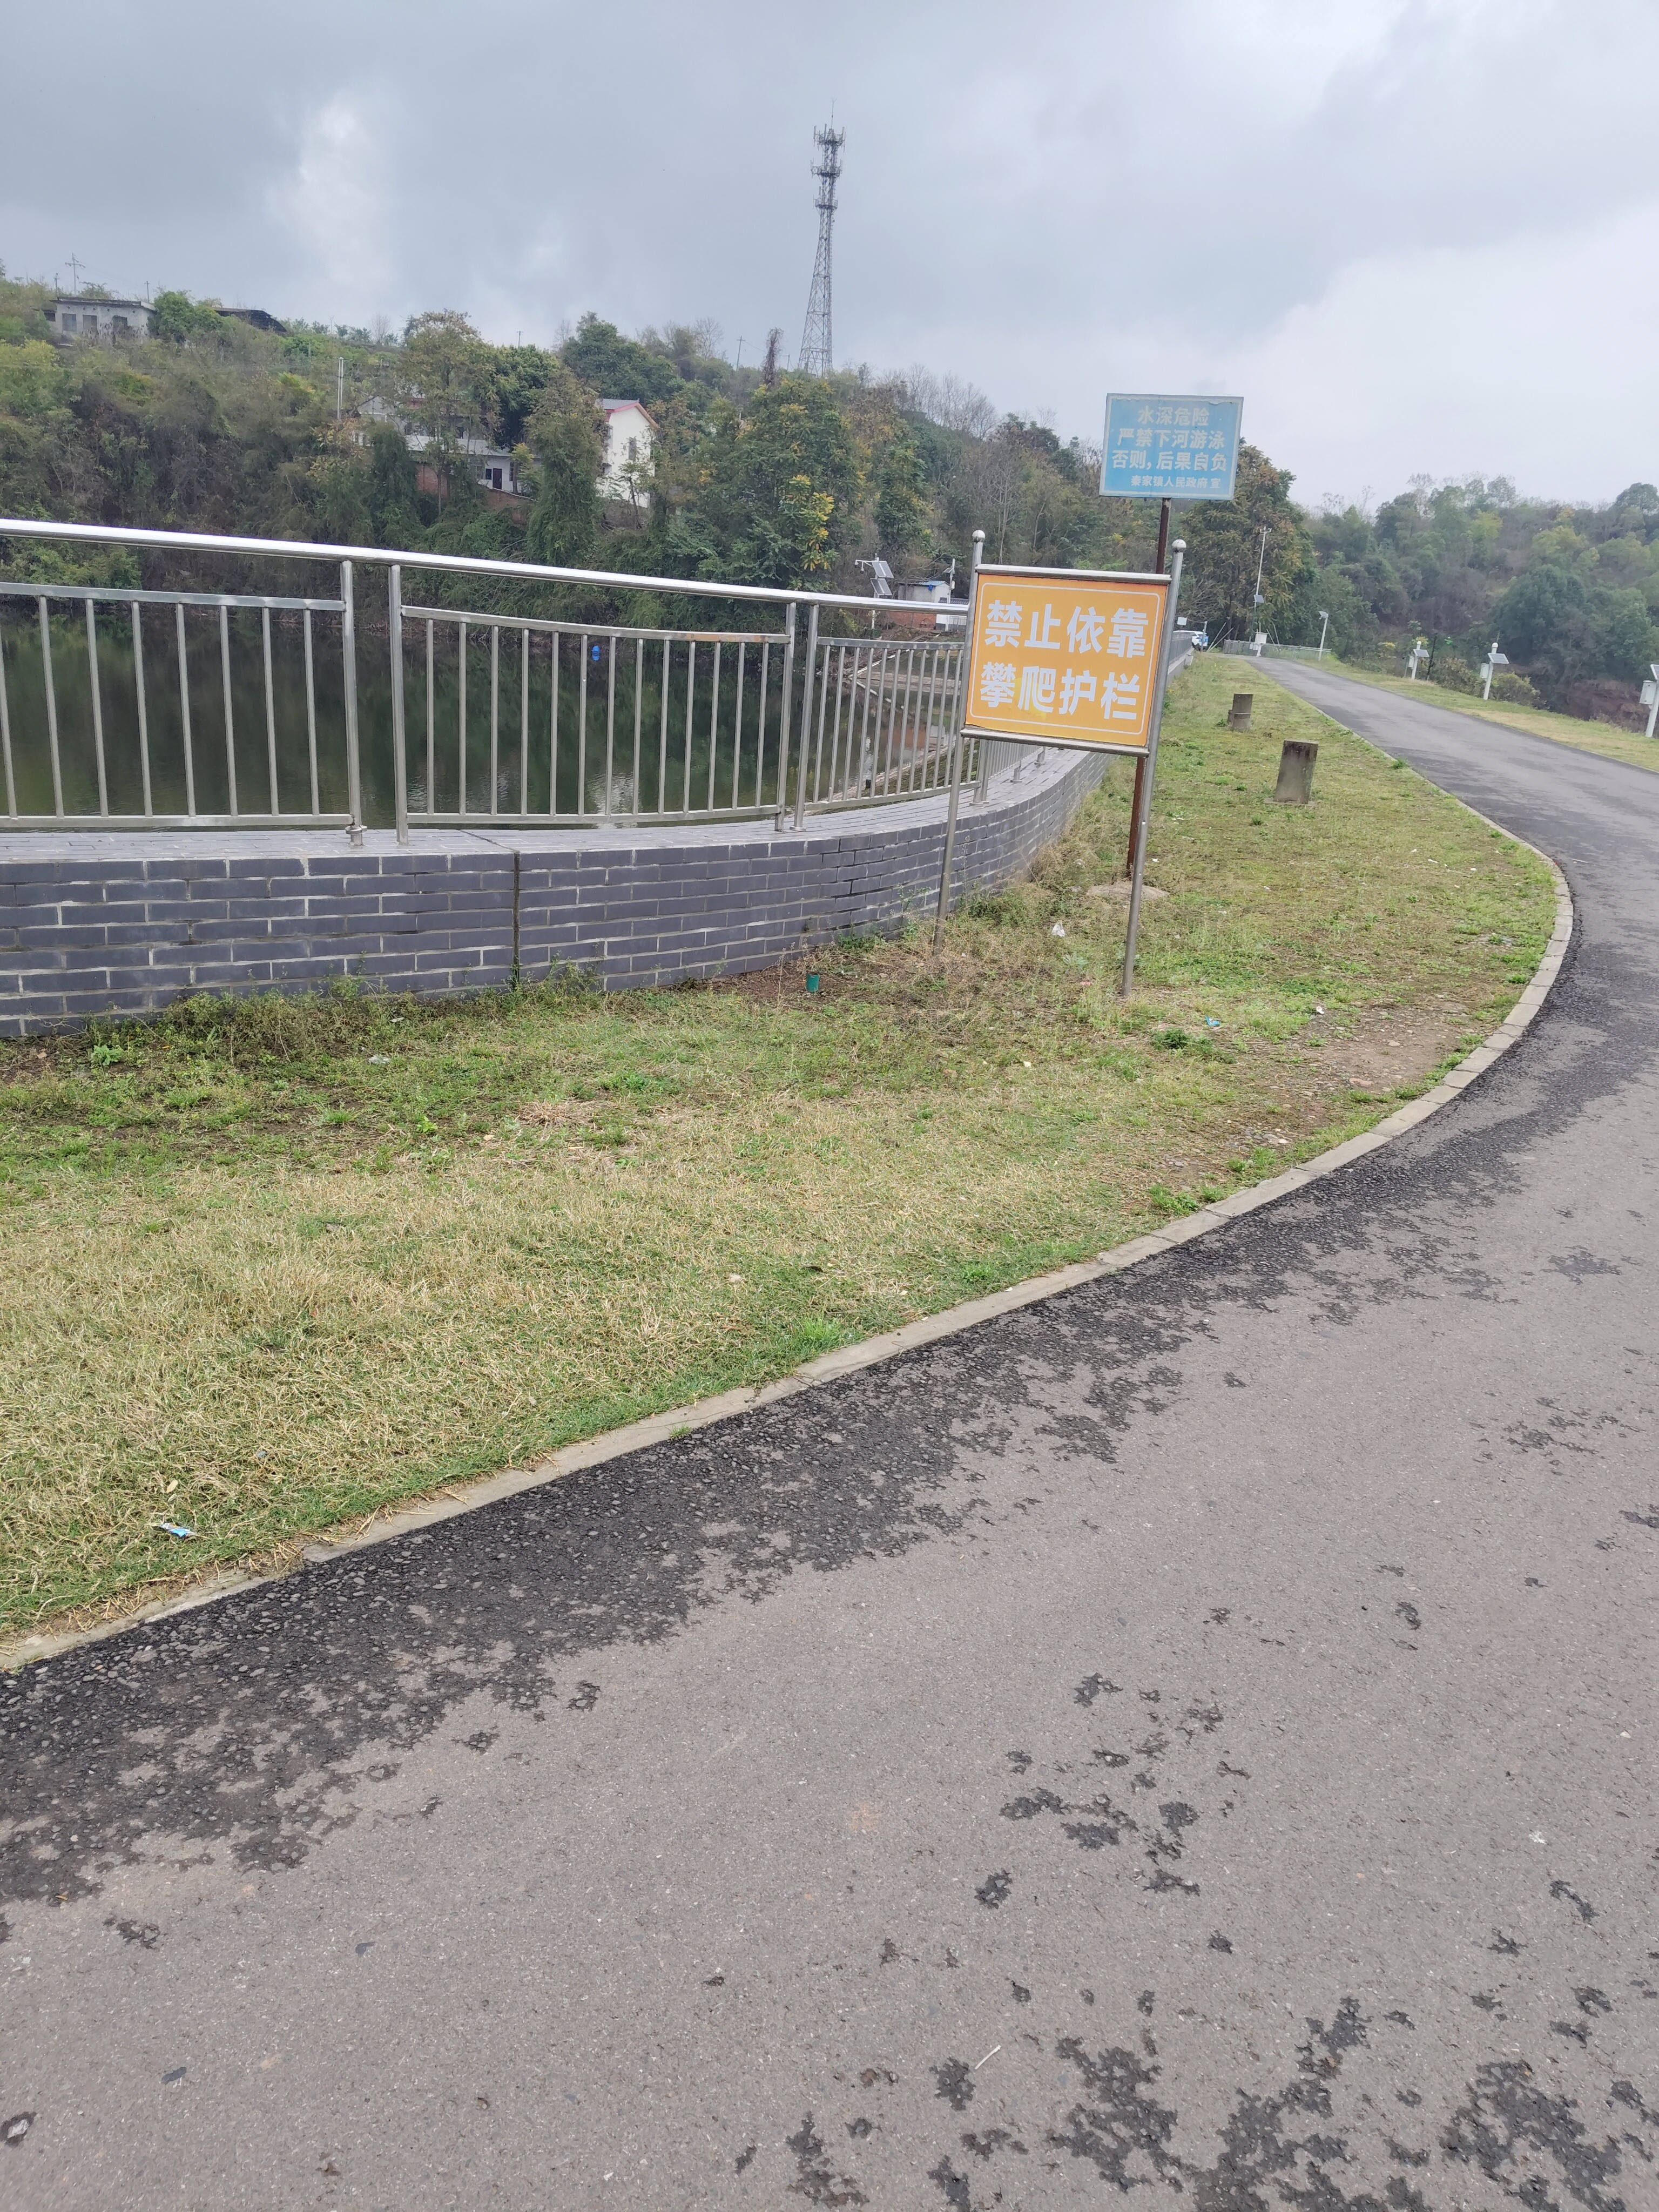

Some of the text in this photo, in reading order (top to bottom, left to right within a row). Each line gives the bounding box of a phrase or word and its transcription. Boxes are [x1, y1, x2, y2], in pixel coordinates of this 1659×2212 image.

[1138, 405, 1210, 426] 水深危险
[1117, 428, 1225, 449] 严禁下河游泳
[985, 599, 1149, 658] 禁止依靠
[980, 662, 1141, 720] 攀爬护栏
